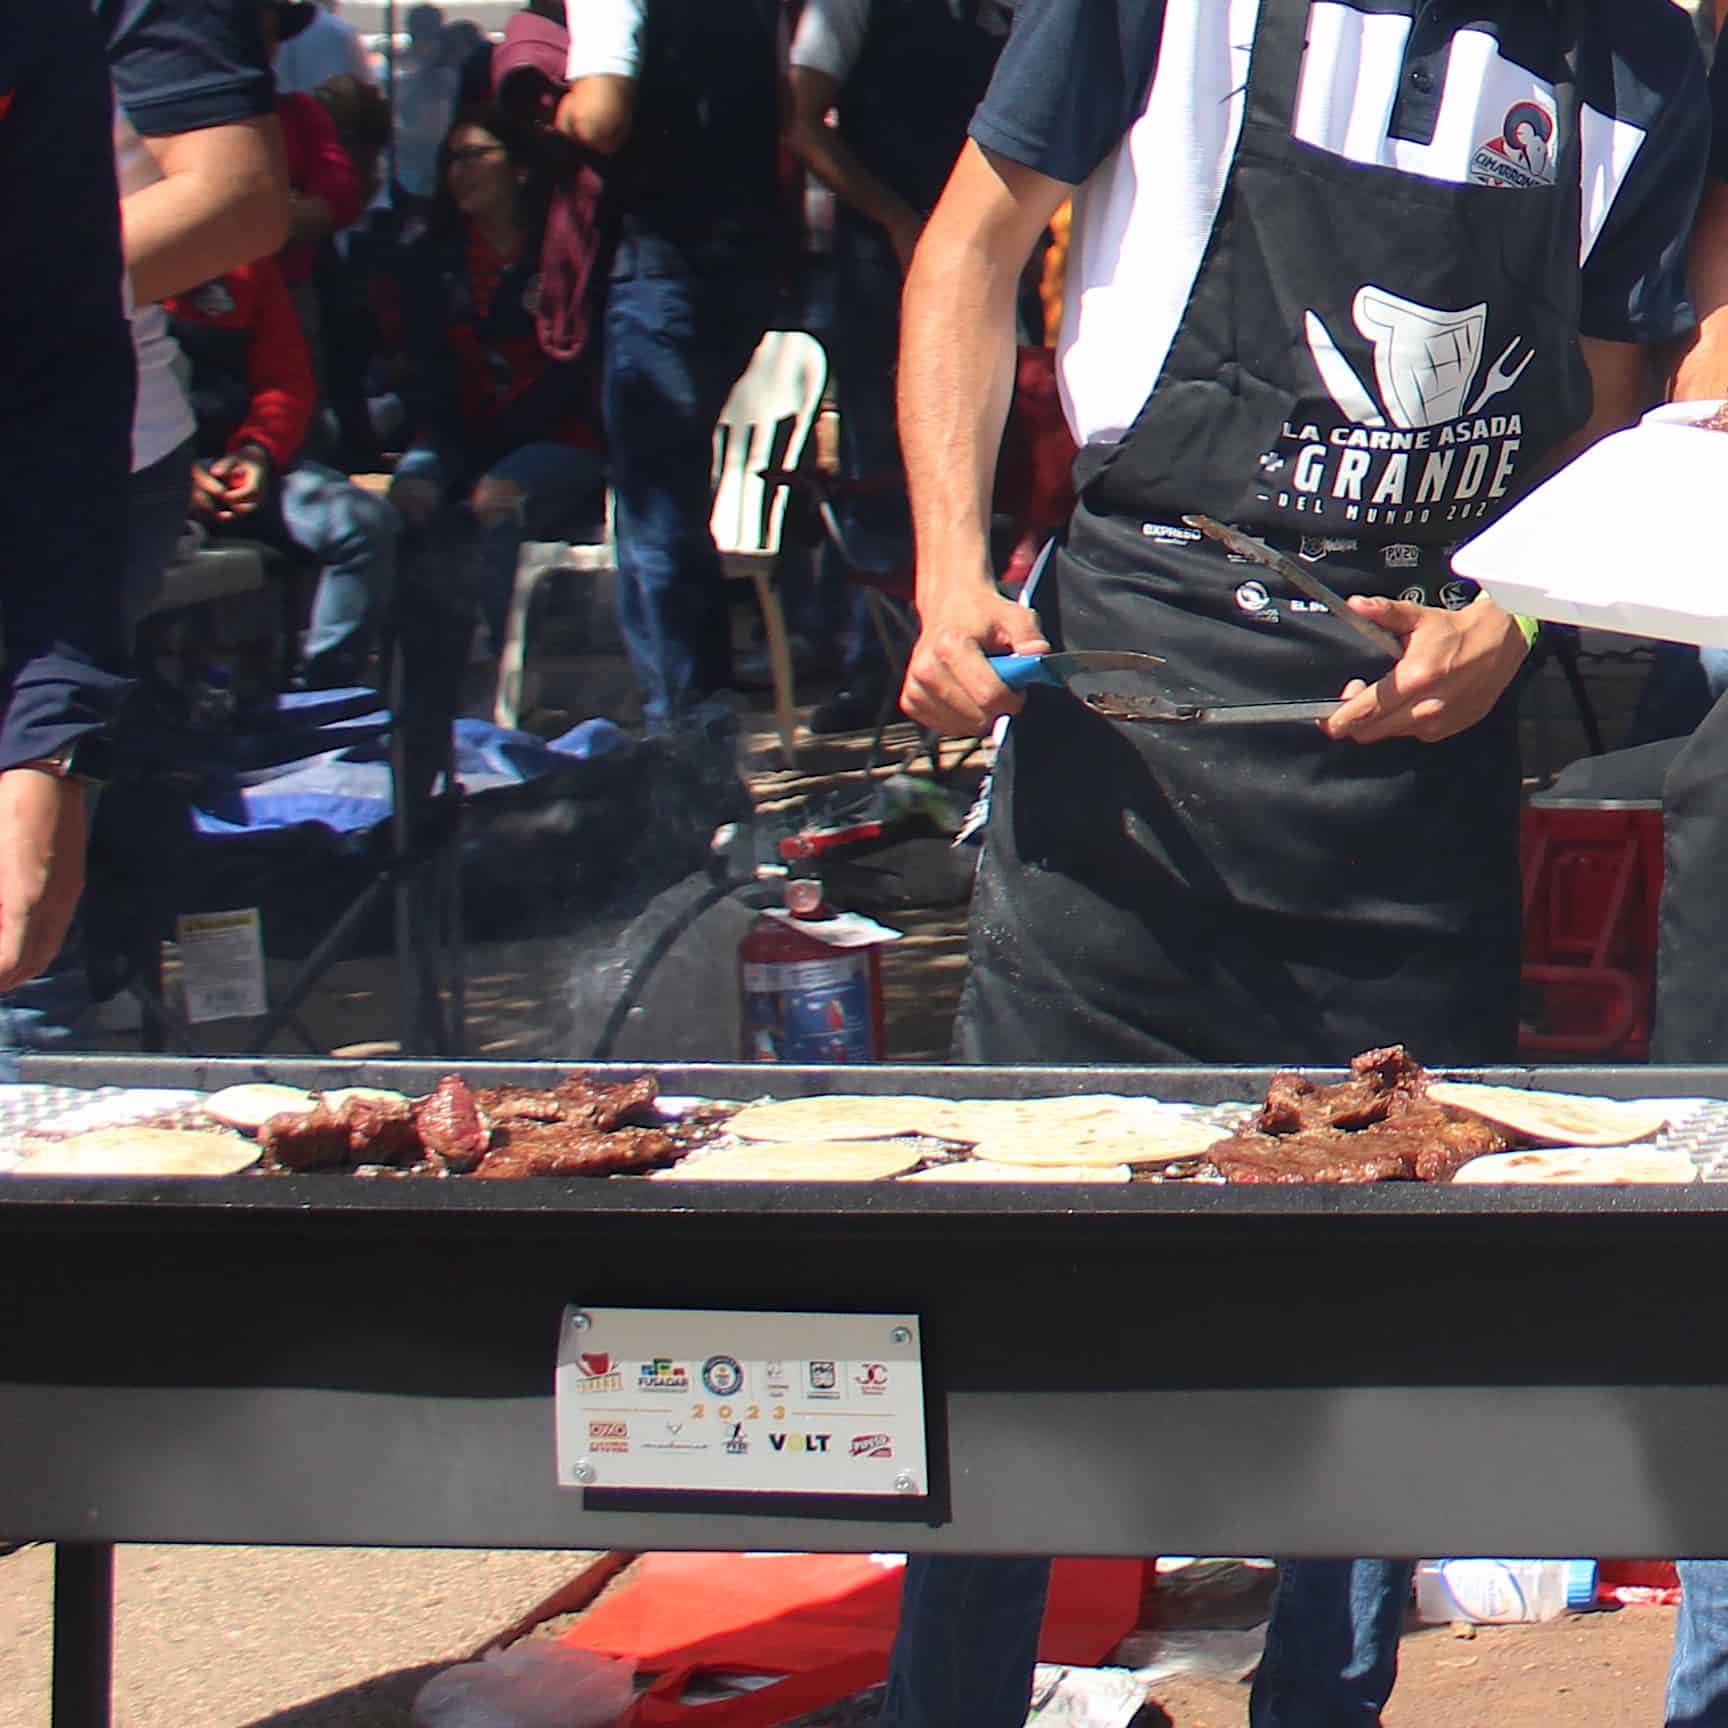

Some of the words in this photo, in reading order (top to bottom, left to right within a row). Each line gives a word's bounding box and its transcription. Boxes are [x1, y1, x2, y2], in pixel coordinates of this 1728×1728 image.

[1282, 421, 1320, 441] LA
[1330, 427, 1430, 450] CARNE
[1438, 414, 1521, 442] ASADA
[1278, 493, 1323, 513] DEL
[1346, 505, 1430, 524] MUNDO
[1447, 501, 1491, 520] 202
[769, 1432, 832, 1452] VOLT
